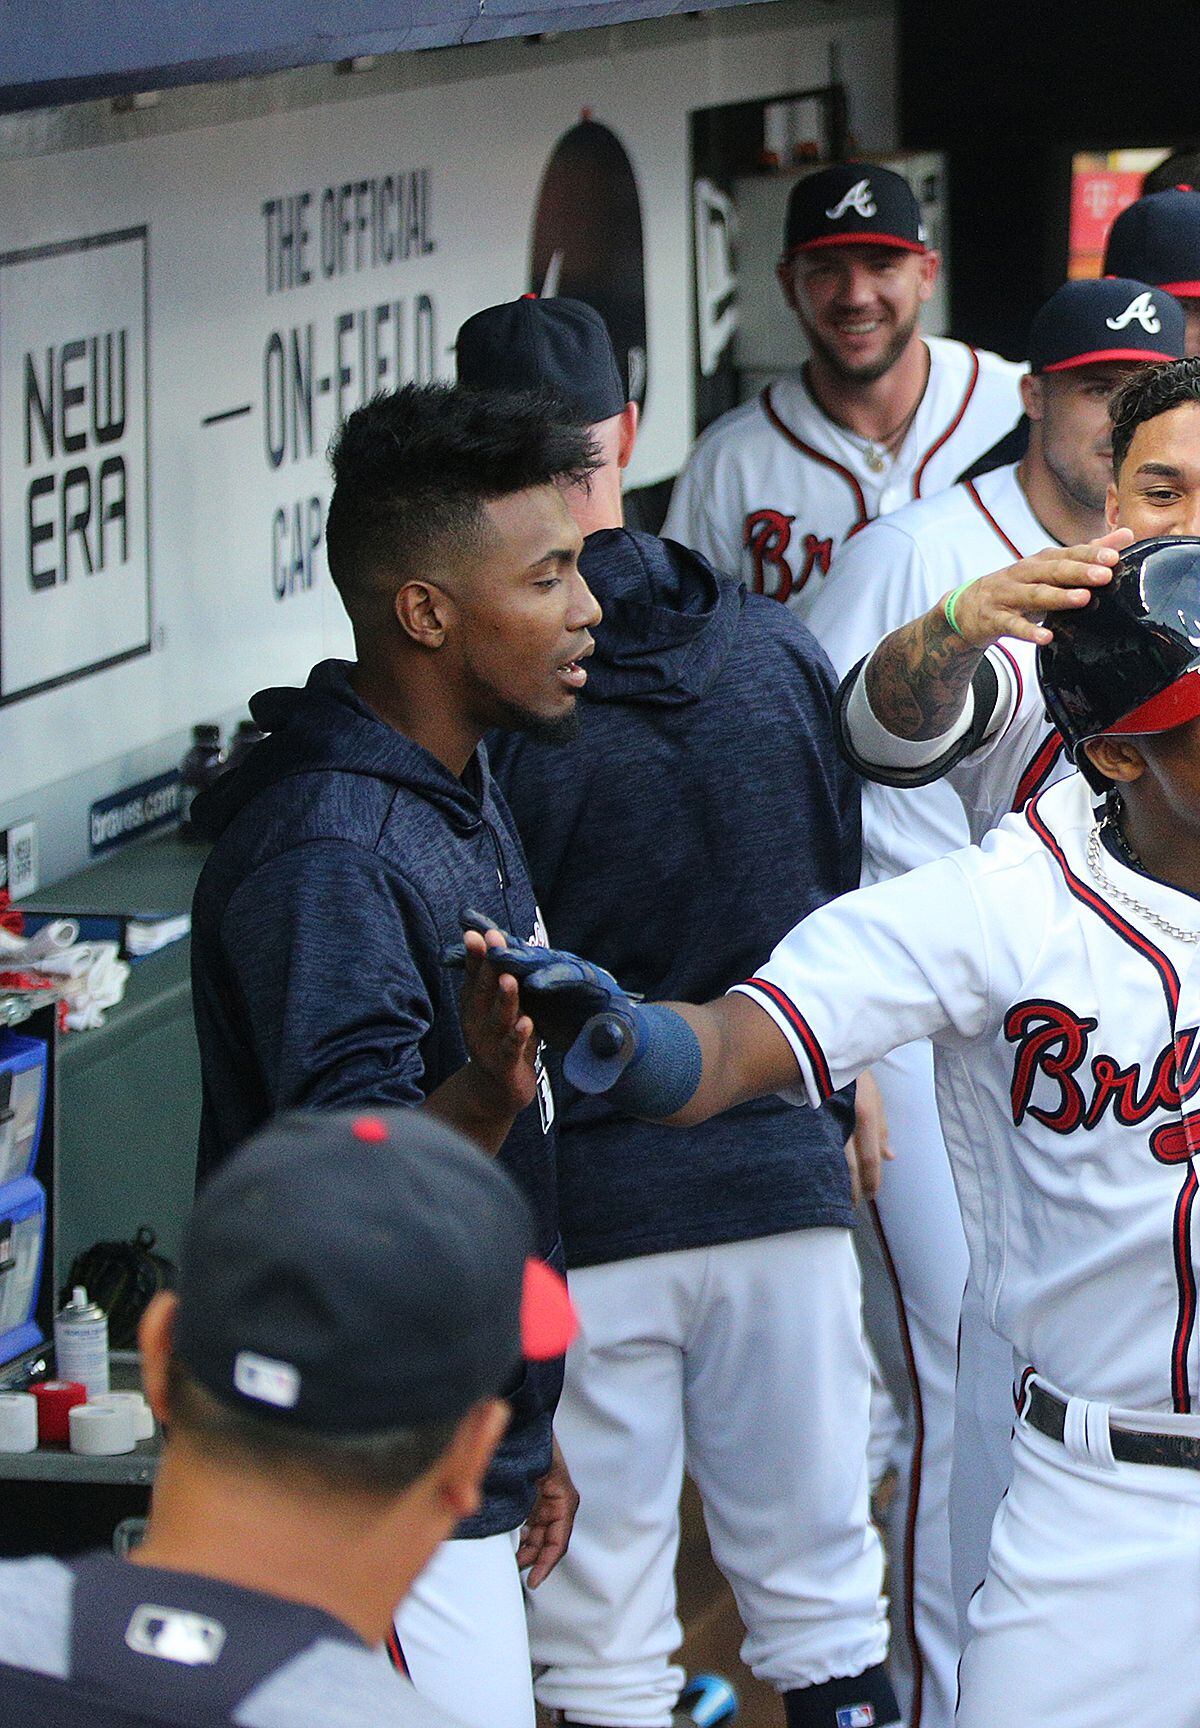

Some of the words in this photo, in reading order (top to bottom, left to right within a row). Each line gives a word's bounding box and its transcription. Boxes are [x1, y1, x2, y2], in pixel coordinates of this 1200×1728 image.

[261, 193, 311, 295] THE
[321, 168, 434, 279] OFFICIAL
[825, 178, 878, 220] A
[1105, 291, 1162, 335] A
[24, 330, 126, 466] NEW
[28, 455, 127, 592] ERA
[272, 496, 322, 602] CAP
